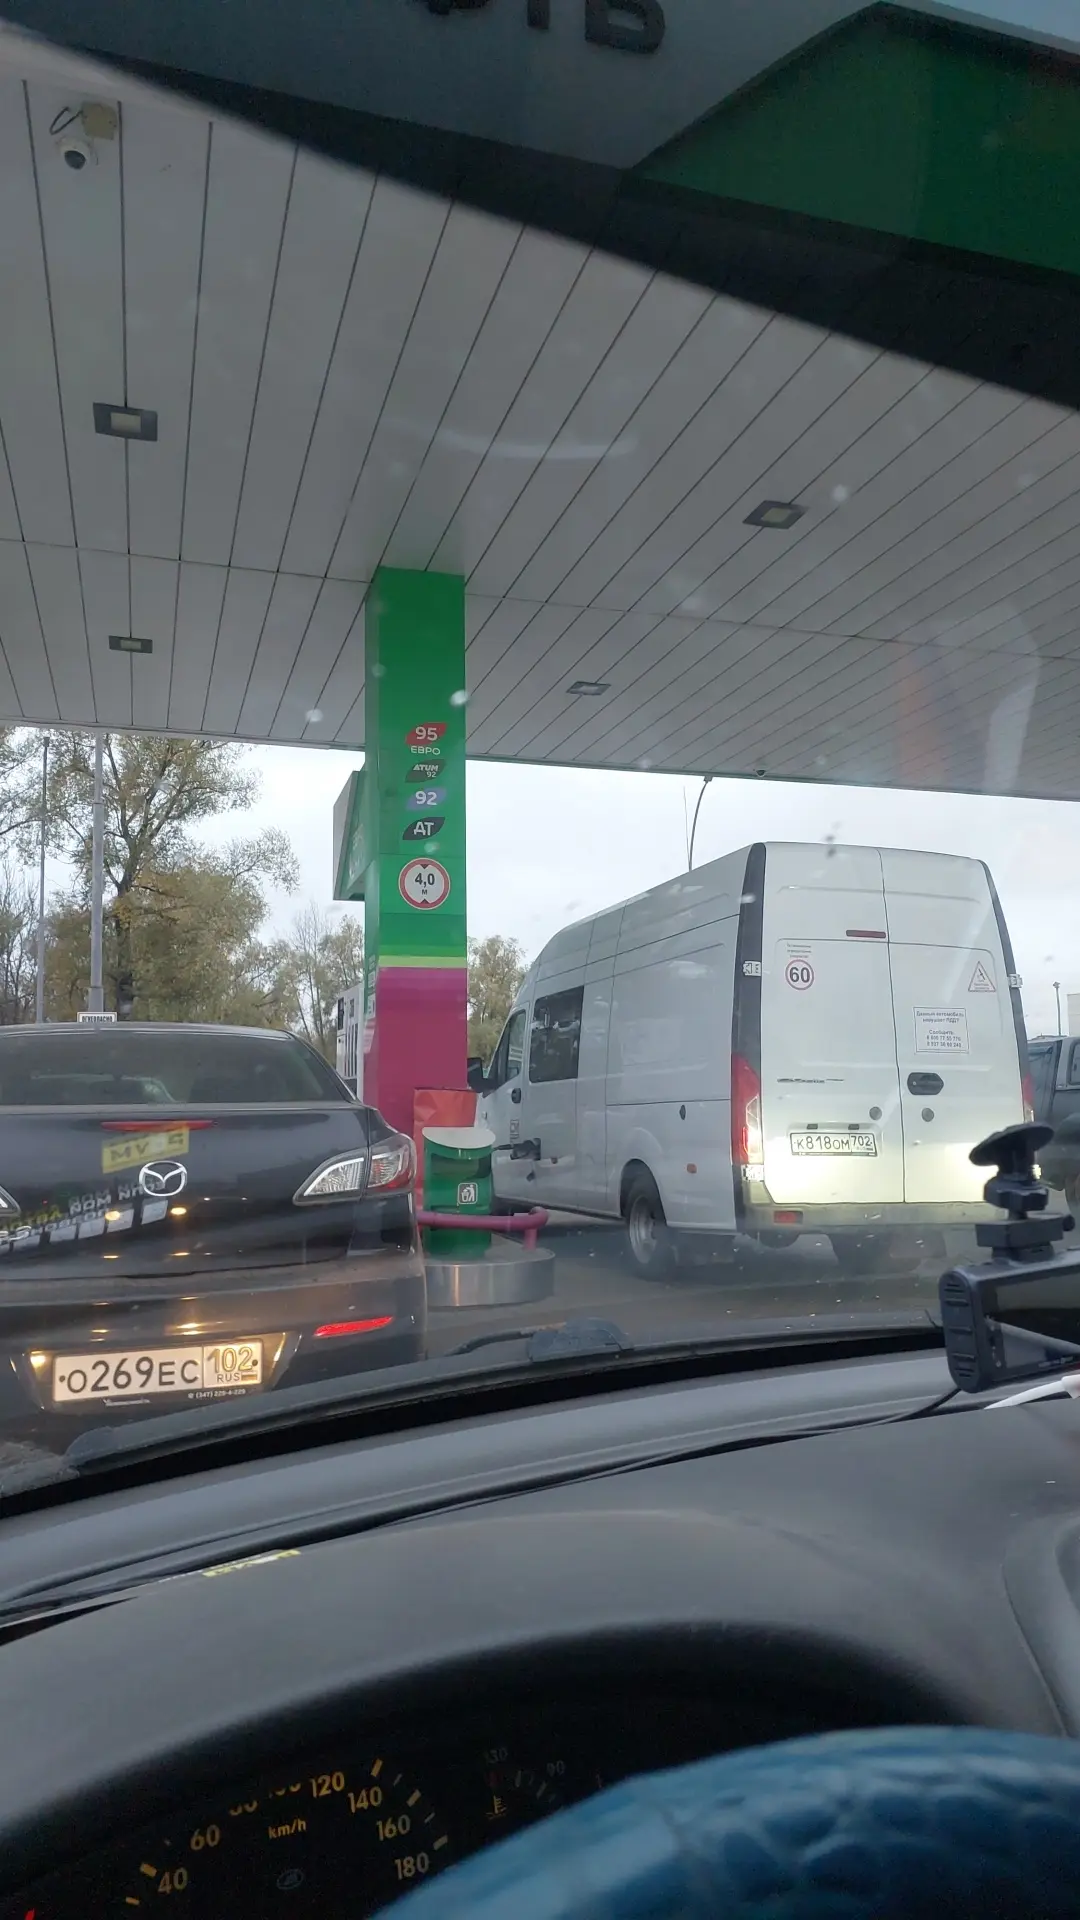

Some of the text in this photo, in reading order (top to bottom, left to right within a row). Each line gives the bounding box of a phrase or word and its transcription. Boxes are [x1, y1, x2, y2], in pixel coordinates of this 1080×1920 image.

[415, 726, 438, 741] 95
[410, 745, 441, 756] ЕВРО
[415, 790, 437, 806] 92
[413, 821, 434, 836] ДТ
[414, 872, 435, 888] 4,0
[789, 966, 811, 983] 60
[851, 1135, 871, 1147] 702
[207, 1346, 253, 1374] 102
[216, 1372, 240, 1383] RUS
[310, 1771, 345, 1798] 120
[347, 1786, 382, 1814] 140
[268, 1818, 307, 1839] km/h
[376, 1814, 411, 1841] 160
[190, 1824, 221, 1851] 60
[394, 1852, 430, 1880] 180
[157, 1866, 188, 1895] 40
